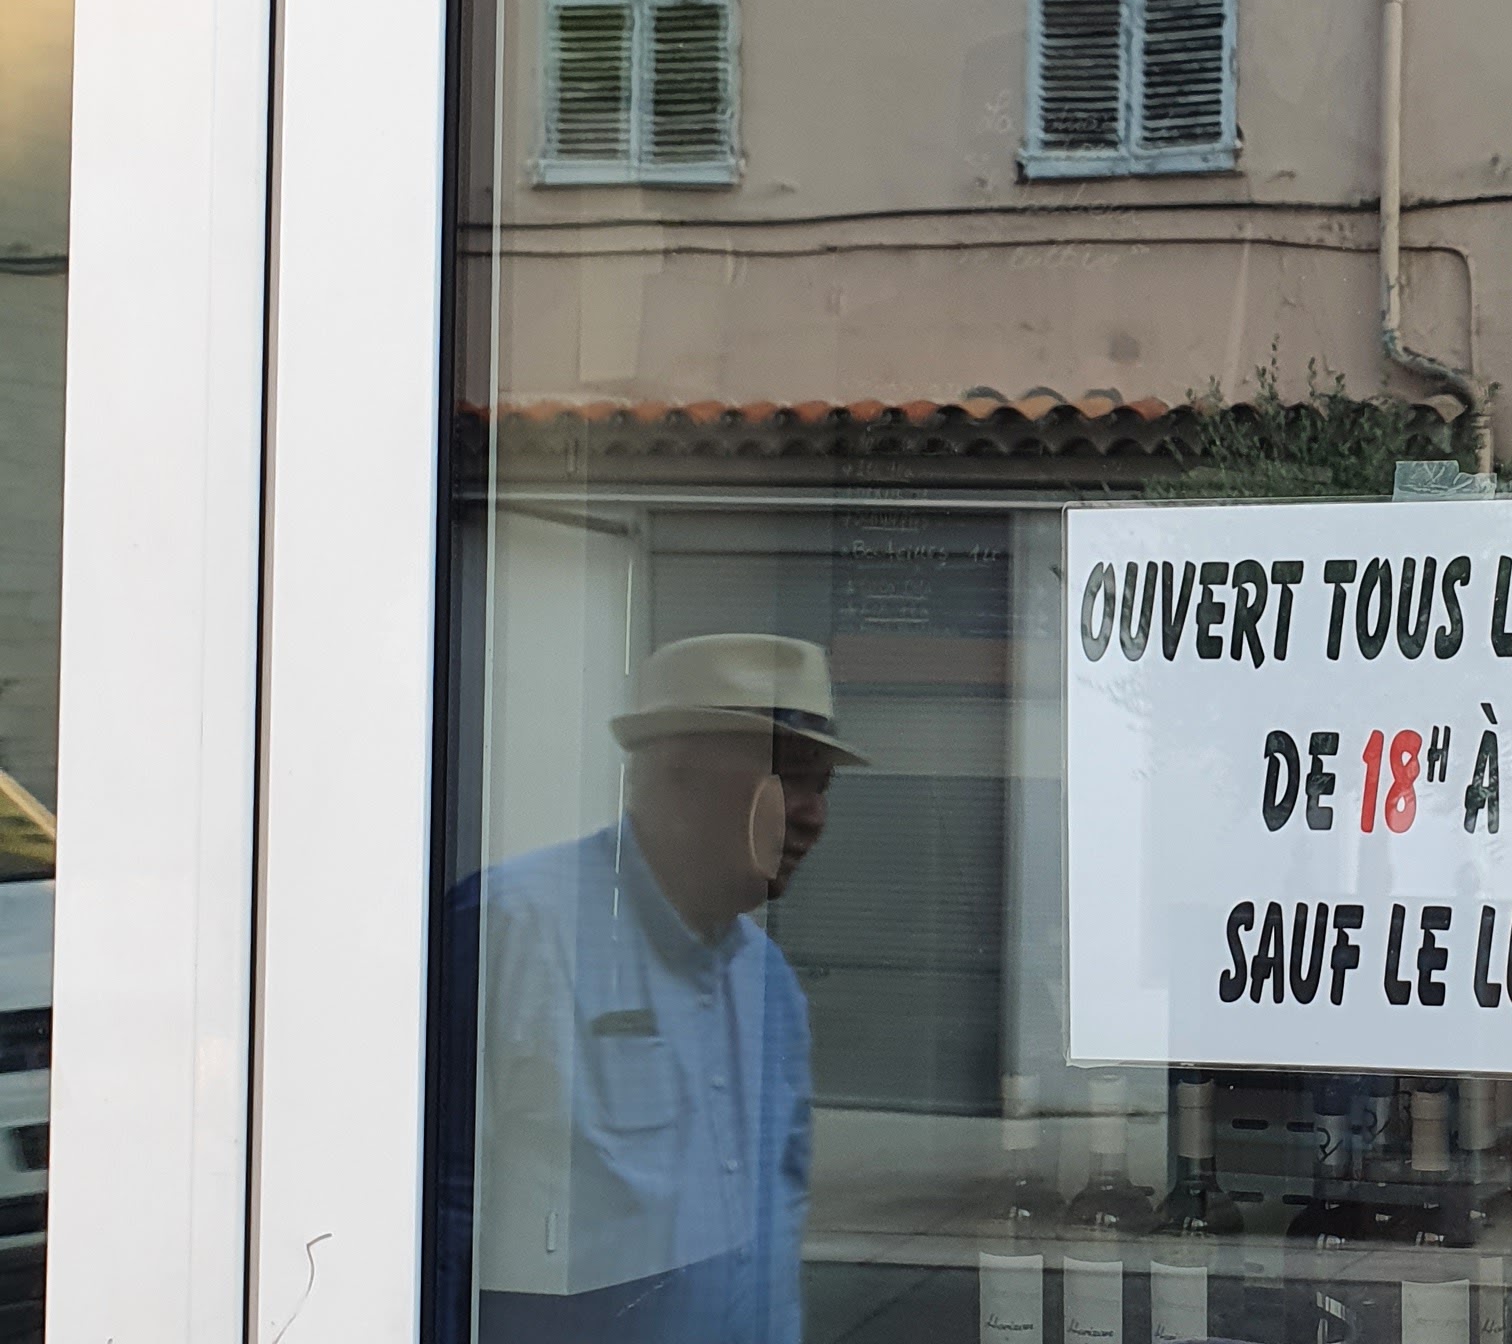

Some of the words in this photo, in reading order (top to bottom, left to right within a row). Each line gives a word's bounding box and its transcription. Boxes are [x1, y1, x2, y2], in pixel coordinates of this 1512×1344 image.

[1080, 558, 1304, 670] OUVERT
[1323, 554, 1471, 662] TOUS
[1261, 729, 1339, 832] DE
[1463, 702, 1500, 833] À
[1218, 901, 1364, 1007] SAUF
[1384, 903, 1452, 1007] LE
